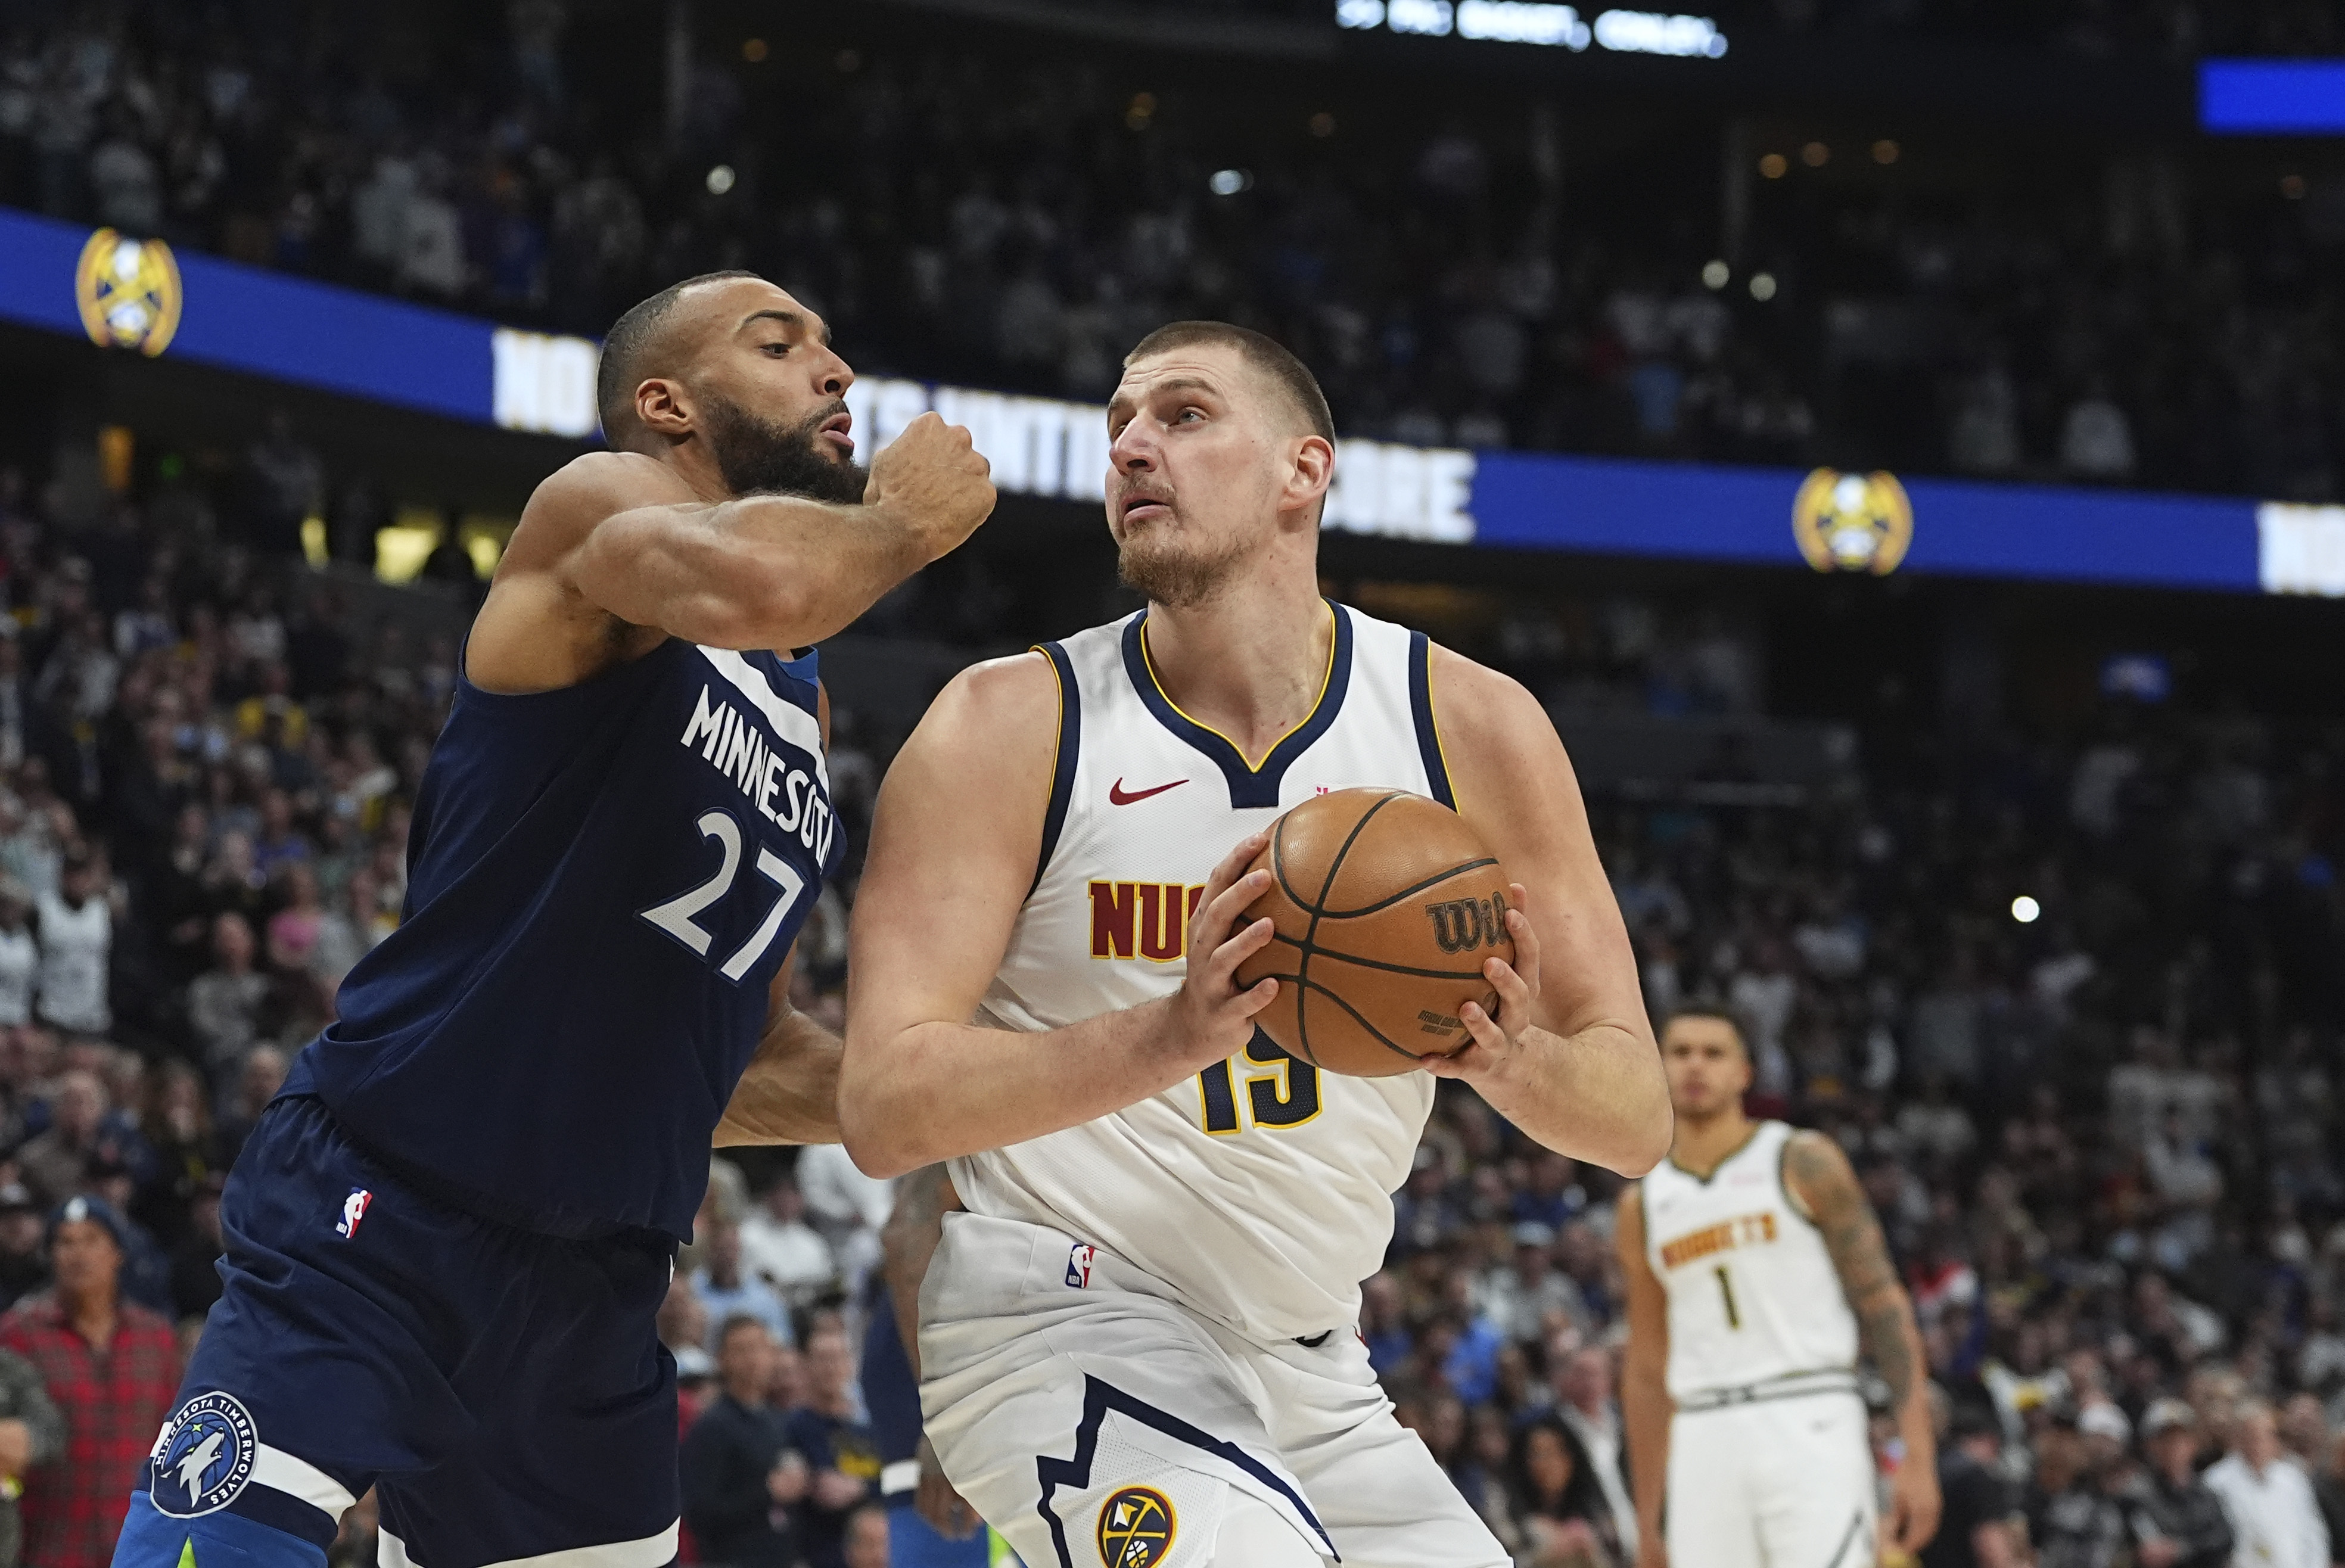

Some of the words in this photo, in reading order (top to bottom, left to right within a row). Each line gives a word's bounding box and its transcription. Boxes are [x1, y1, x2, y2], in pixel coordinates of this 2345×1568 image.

[636, 809, 807, 984] 27
[1068, 1274, 1080, 1286] NBA
[1713, 1265, 1740, 1331] 1
[155, 1398, 213, 1466] MINNESOTA
[210, 1399, 253, 1505] TIMBERWOLVES
